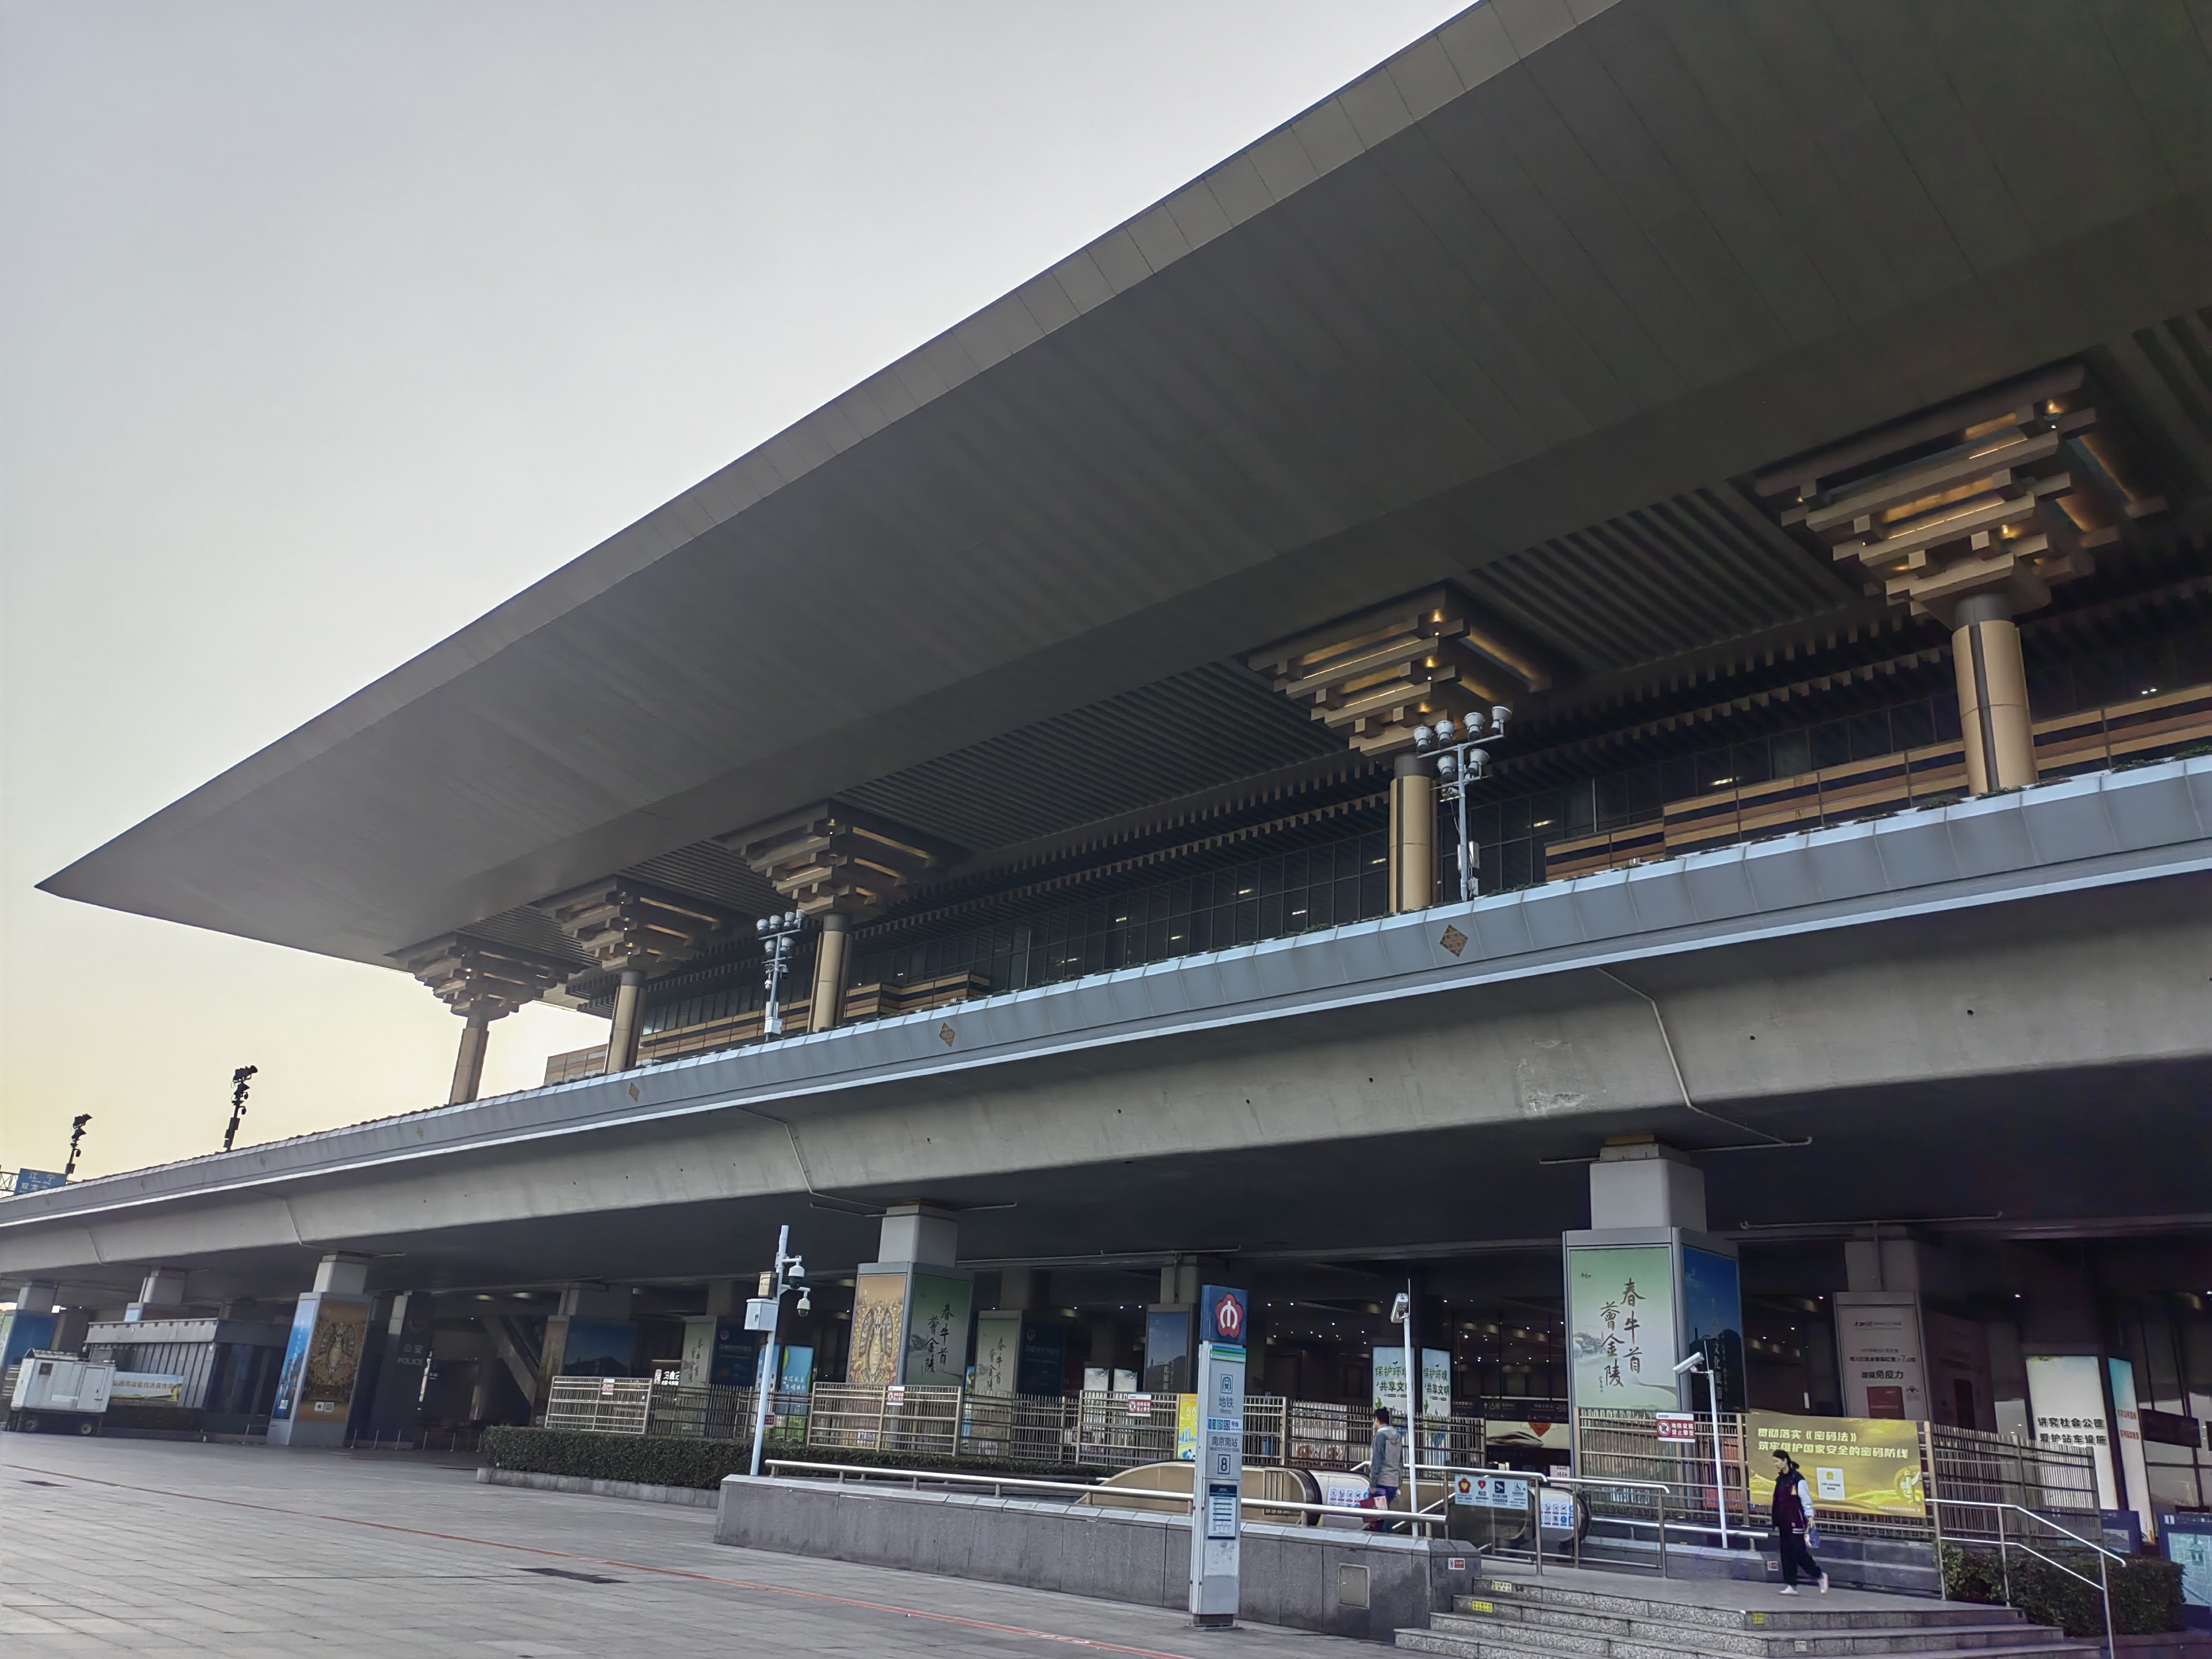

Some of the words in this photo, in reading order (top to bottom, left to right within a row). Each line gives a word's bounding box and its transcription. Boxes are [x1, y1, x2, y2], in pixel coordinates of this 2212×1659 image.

[29, 1172, 55, 1182] 江宁
[404, 1343, 424, 1353] 公安
[397, 1357, 423, 1366] POLICE
[1424, 1368, 1447, 1381] 保护环境
[1427, 1382, 1449, 1396] 共享文明
[1219, 1396, 1234, 1408] 地铁
[1217, 1421, 1223, 1429] S1
[2038, 1417, 2104, 1428] 讲究社会公德
[1758, 1428, 1857, 1442] 贯彻落实《密码法》
[2040, 1433, 2106, 1445] 爱护站车设施
[1212, 1436, 1238, 1447] 南京南站
[1758, 1441, 1908, 1459] 筑牢维护国家安全的密码防线
[1221, 1458, 1228, 1471] 8
